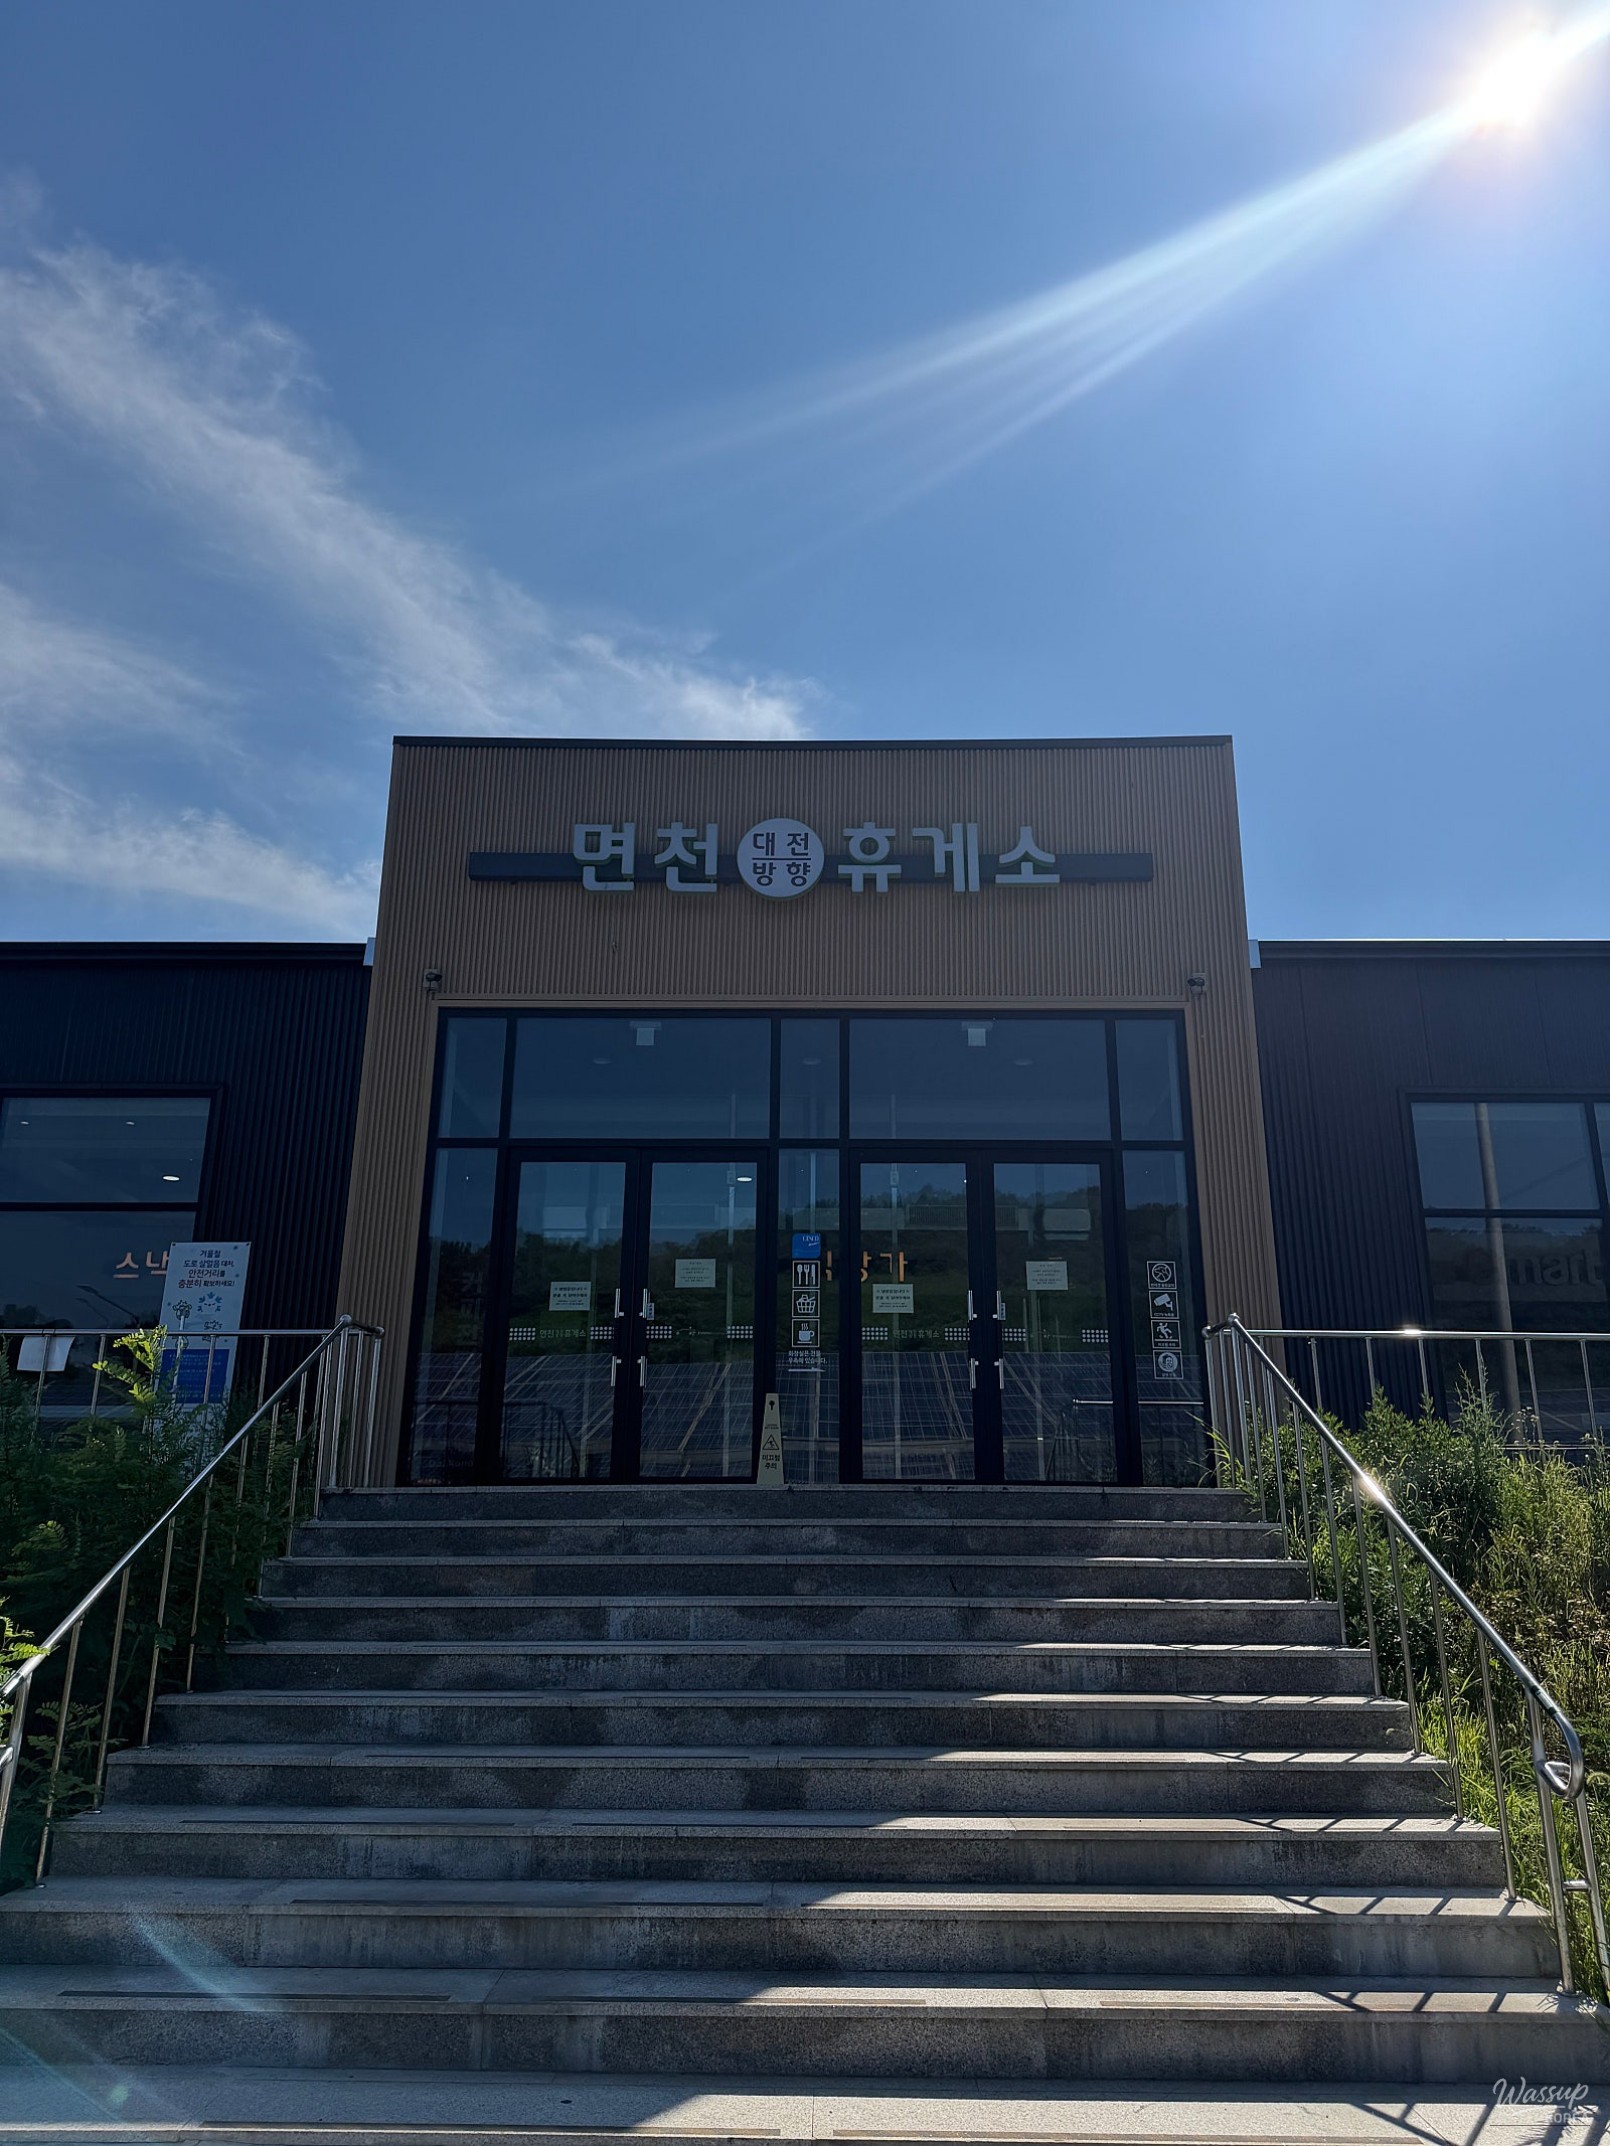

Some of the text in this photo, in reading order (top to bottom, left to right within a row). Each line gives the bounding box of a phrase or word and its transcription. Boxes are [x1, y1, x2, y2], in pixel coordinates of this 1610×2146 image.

[752, 831, 811, 857] 대전
[573, 821, 1061, 894] 면천 휴게소
[752, 860, 812, 887] 방향
[188, 1268, 226, 1279] 안전거리를
